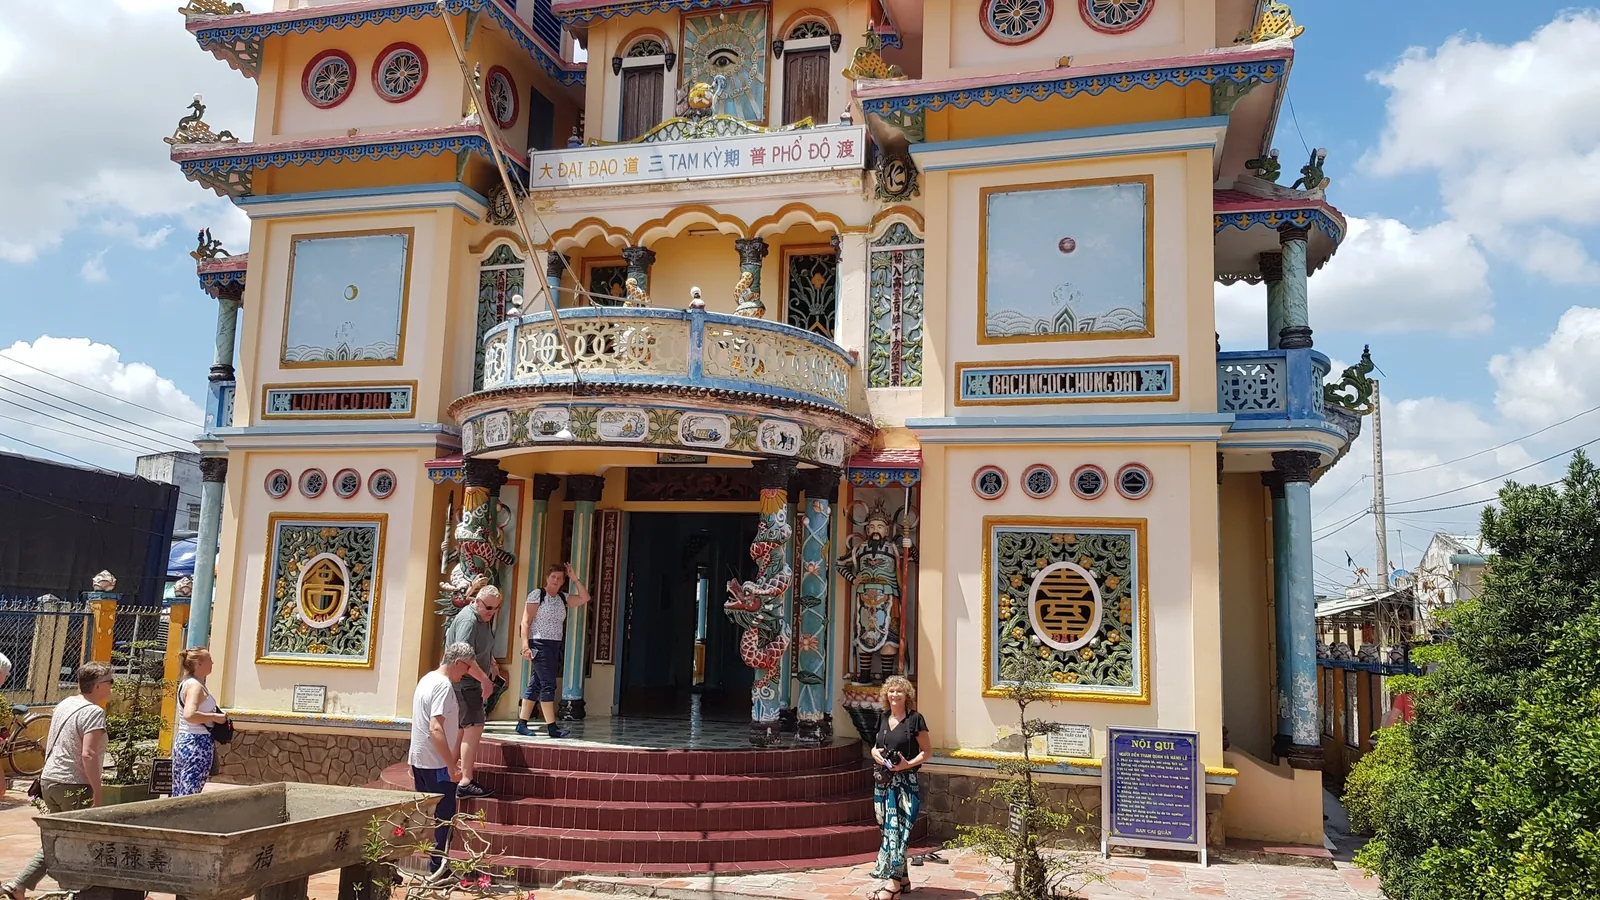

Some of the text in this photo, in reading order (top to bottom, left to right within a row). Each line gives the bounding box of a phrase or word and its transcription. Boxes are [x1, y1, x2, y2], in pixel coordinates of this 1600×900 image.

[538, 162, 553, 180] 大
[622, 156, 639, 176] 道
[648, 155, 663, 173] 三
[668, 152, 698, 171] TAM
[703, 146, 722, 169] KỲ
[724, 149, 740, 168] 期
[750, 146, 767, 168] 普
[772, 136, 802, 163] PHỔ
[808, 137, 831, 162] ĐỘ
[836, 139, 855, 159] 渡
[1131, 738, 1175, 752] NỘI QUI
